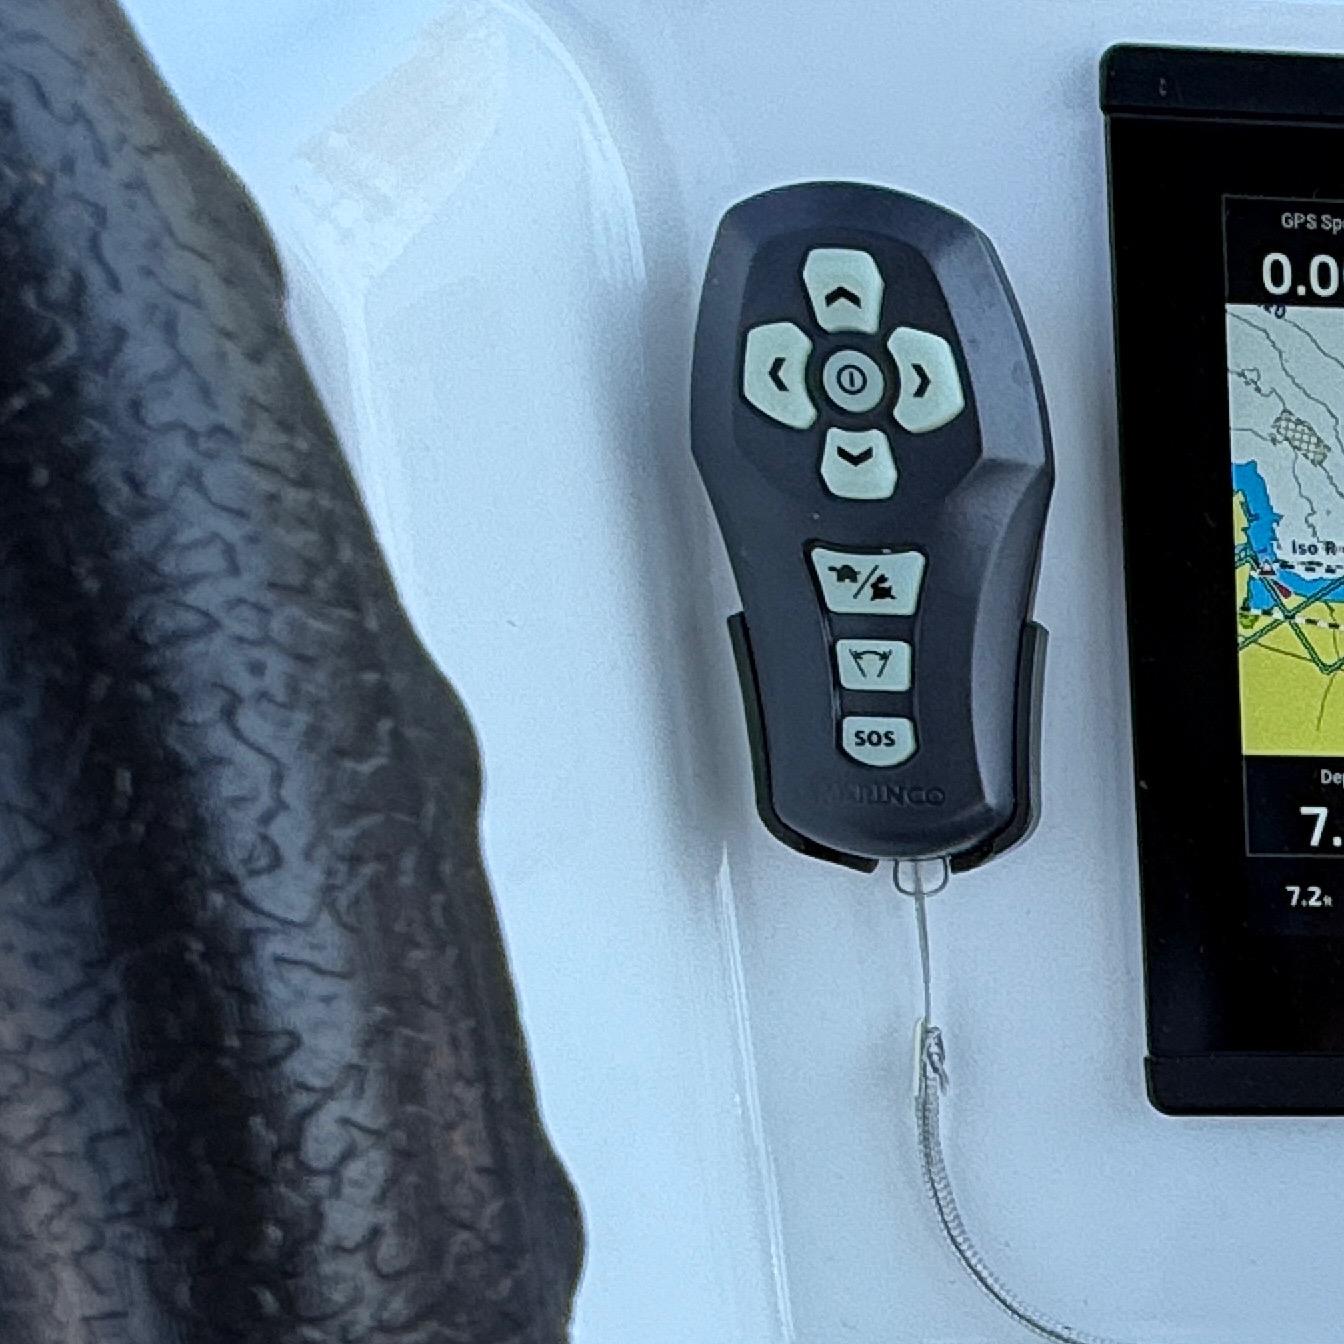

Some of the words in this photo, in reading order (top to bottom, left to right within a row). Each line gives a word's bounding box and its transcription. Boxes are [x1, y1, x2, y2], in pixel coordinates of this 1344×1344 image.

[1281, 213, 1317, 229] GPS
[854, 730, 896, 747] SOS
[1285, 885, 1322, 908] 7.2
